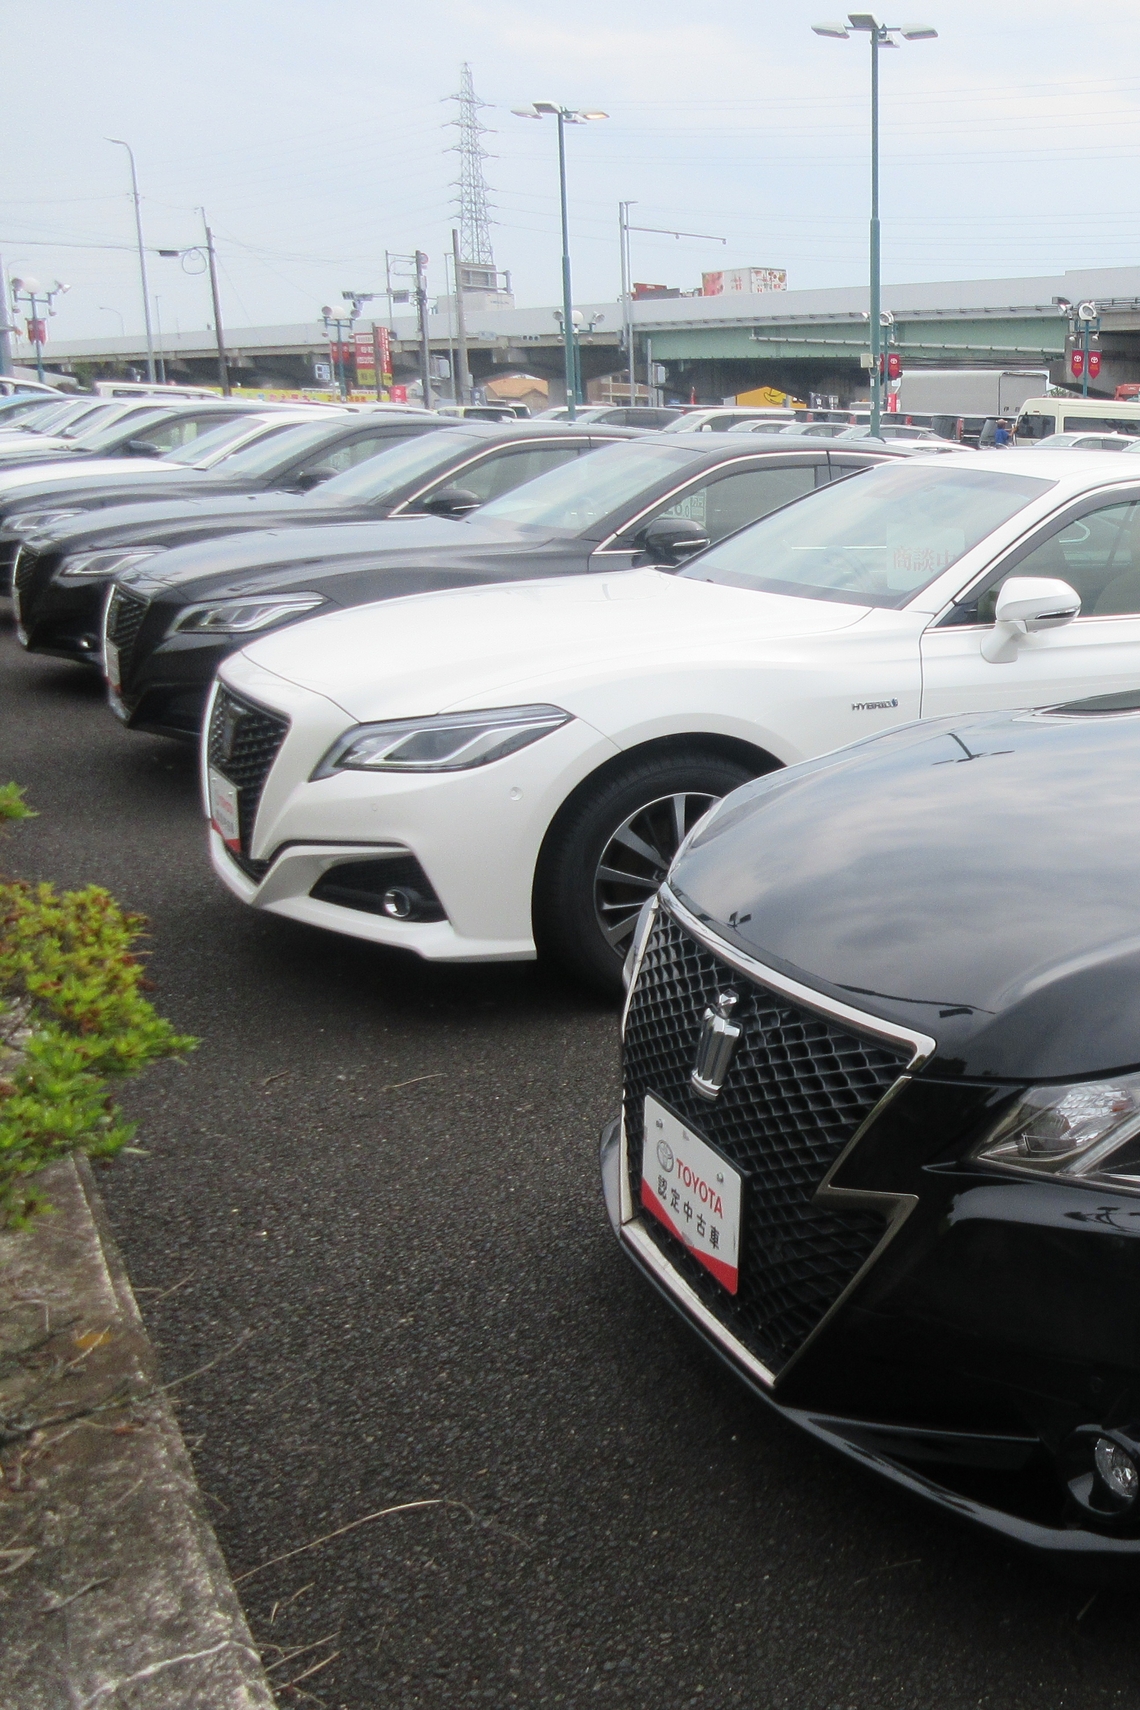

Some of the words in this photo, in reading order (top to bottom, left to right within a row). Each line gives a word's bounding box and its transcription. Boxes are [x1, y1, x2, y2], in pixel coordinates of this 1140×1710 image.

[852, 700, 891, 711] HYBRID
[656, 1174, 720, 1251] 認定中古車
[675, 1157, 724, 1219] TOYOTA
